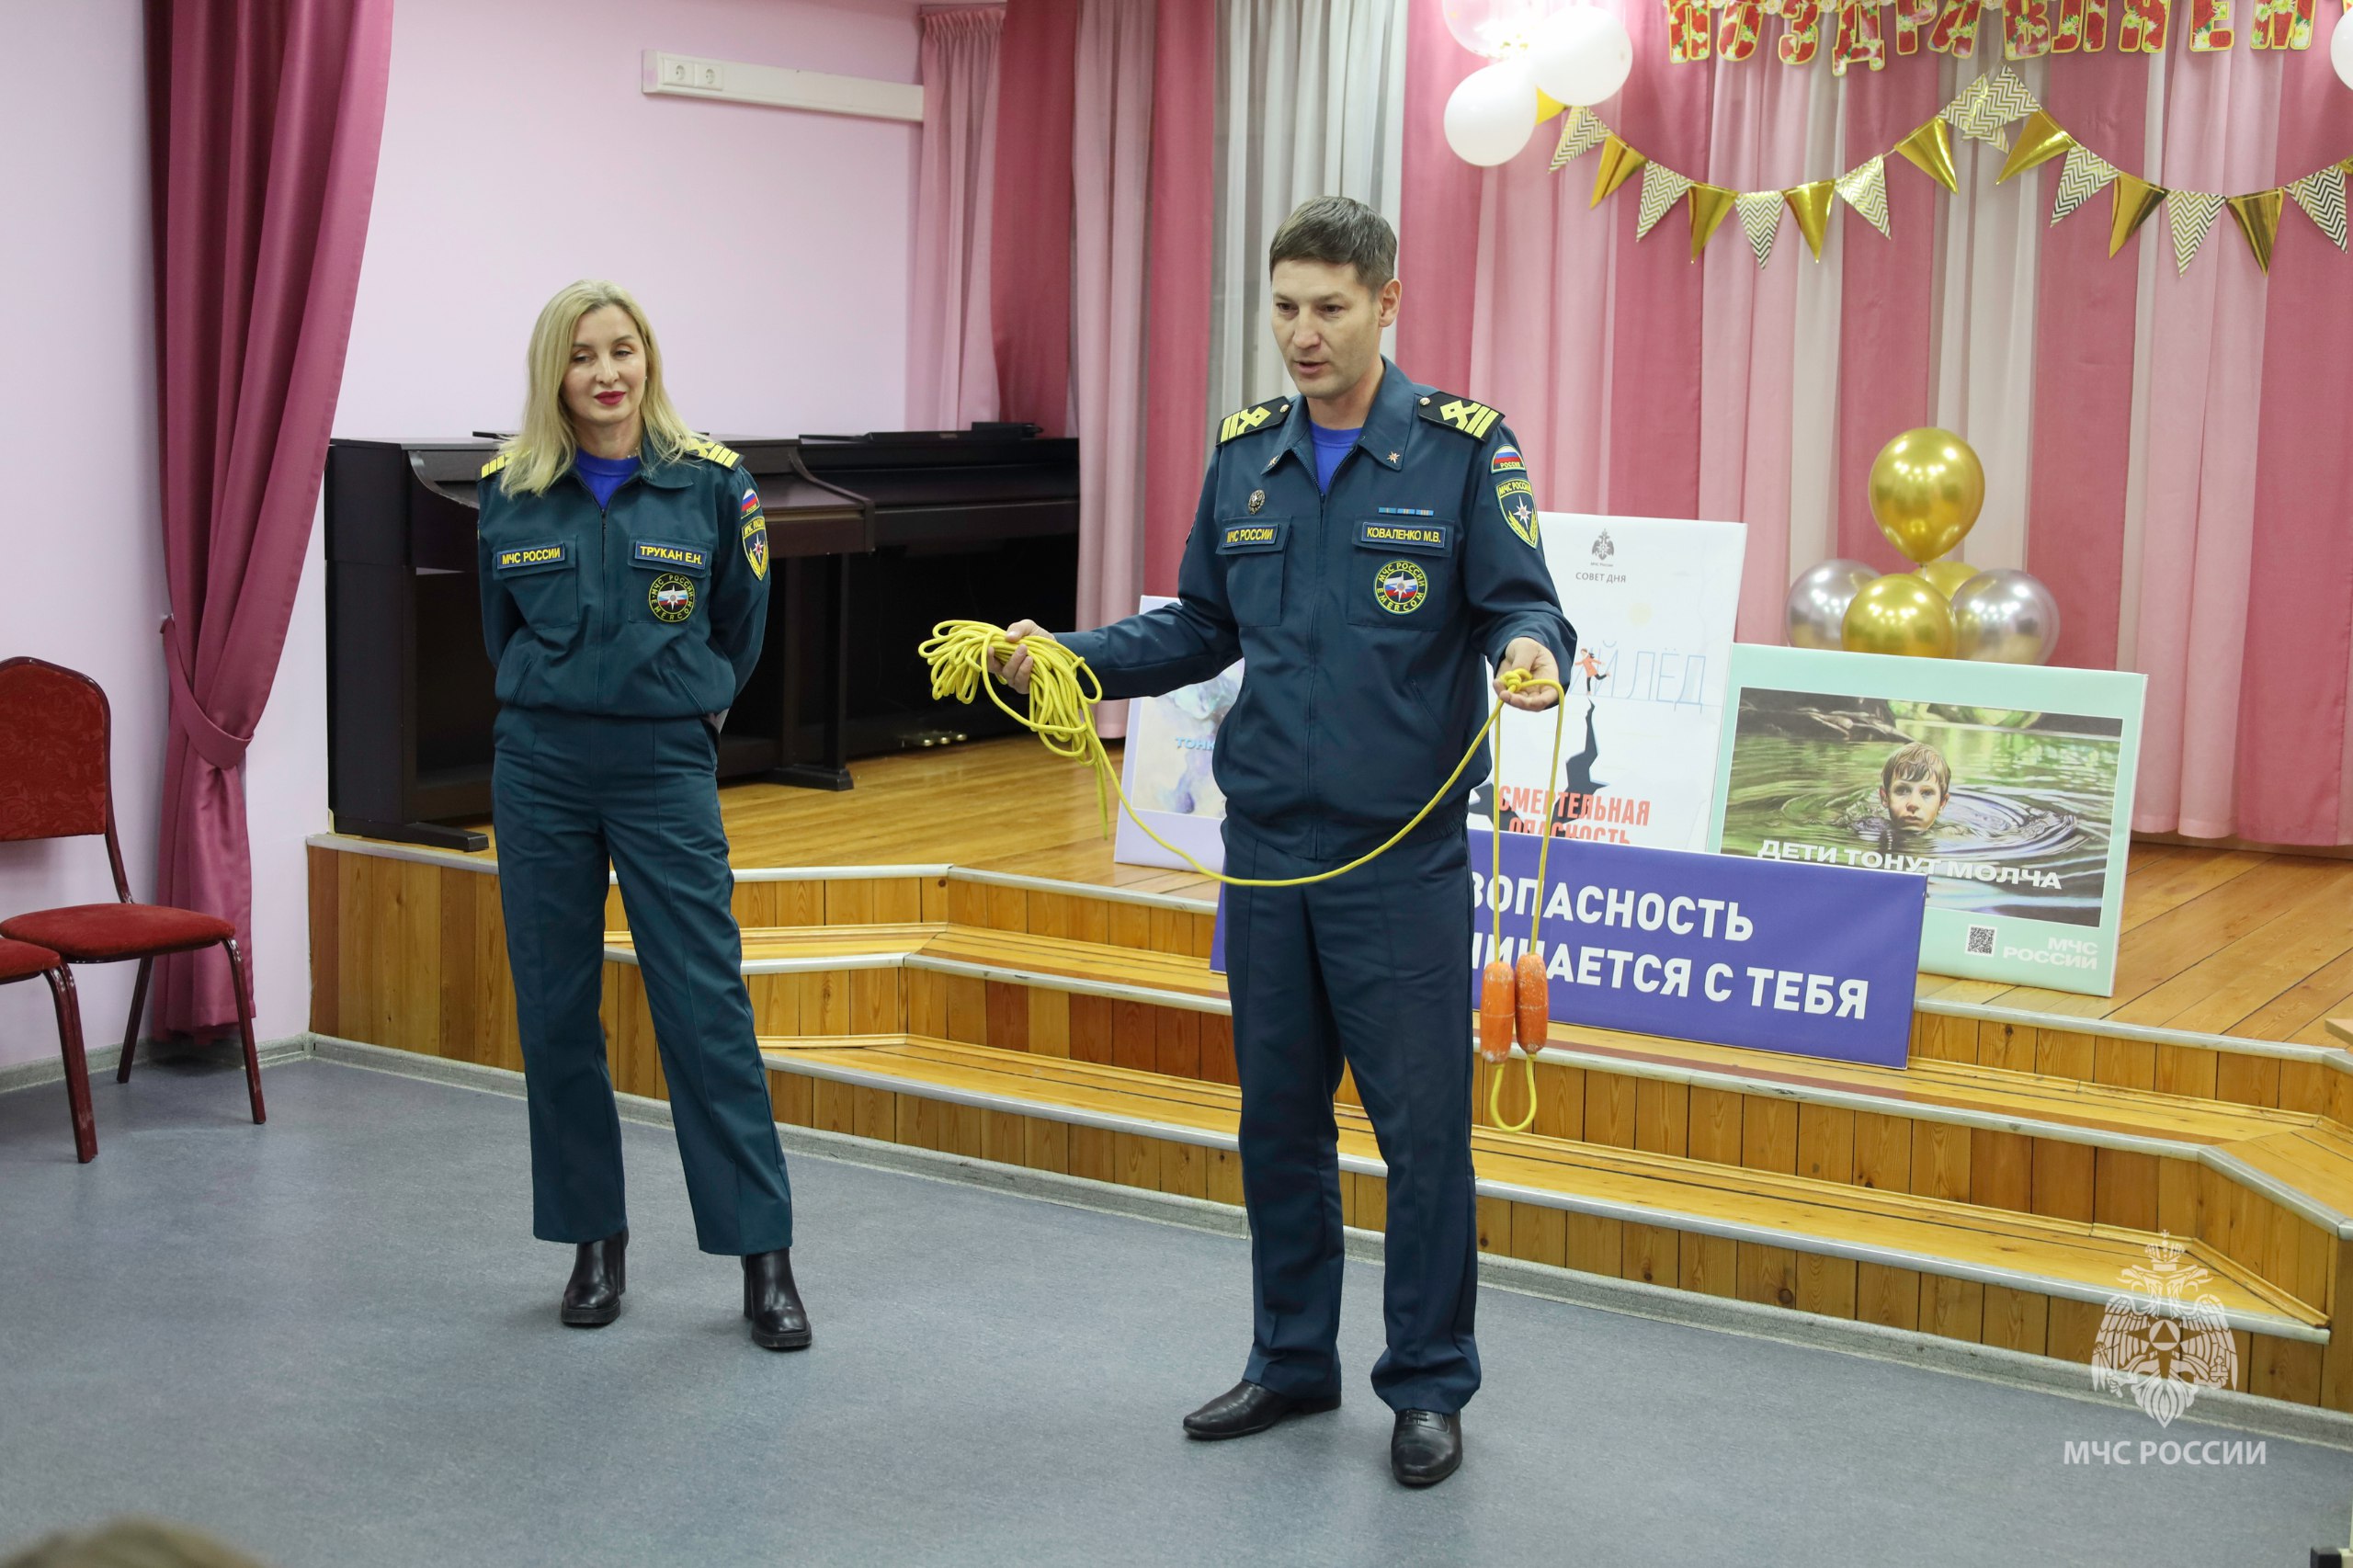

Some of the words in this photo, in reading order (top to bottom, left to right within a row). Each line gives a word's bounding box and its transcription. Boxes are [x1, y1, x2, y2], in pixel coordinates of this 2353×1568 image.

[1668, 0, 2316, 75] ПОЗДРАВЛЯЕМ
[1240, 528, 1274, 541] РОССИИ
[1367, 527, 1422, 541] КОВАЛЕНКО
[1423, 530, 1441, 543] М.В.
[502, 551, 521, 565] МЧС
[523, 547, 561, 562] РОССИИ
[640, 545, 683, 562] ТРУКАН
[685, 552, 702, 565] Е.Н.
[651, 578, 665, 596] МЧС
[668, 574, 694, 597] РОССИИ
[1378, 564, 1394, 583] МЧС
[1396, 562, 1426, 587] РОССИИ
[1575, 572, 1605, 582] СОВЕТ
[1606, 574, 1627, 585] ДНЯ
[651, 598, 693, 620] EMERCOM
[1376, 587, 1425, 611] EMERCOM
[1626, 646, 1707, 714] ЛЁД
[1498, 785, 1651, 826] СМЕРТЕЛЬНАЯ
[1756, 839, 1838, 864] ДЕТИ
[1844, 848, 1942, 875] ТОНУТ
[1947, 859, 2062, 890] МОЛЧА
[2048, 937, 2098, 955] МЧС
[2003, 946, 2097, 970] РОССИИ
[1704, 962, 1734, 1002] С
[1746, 967, 1869, 1020] ТЕБЯ
